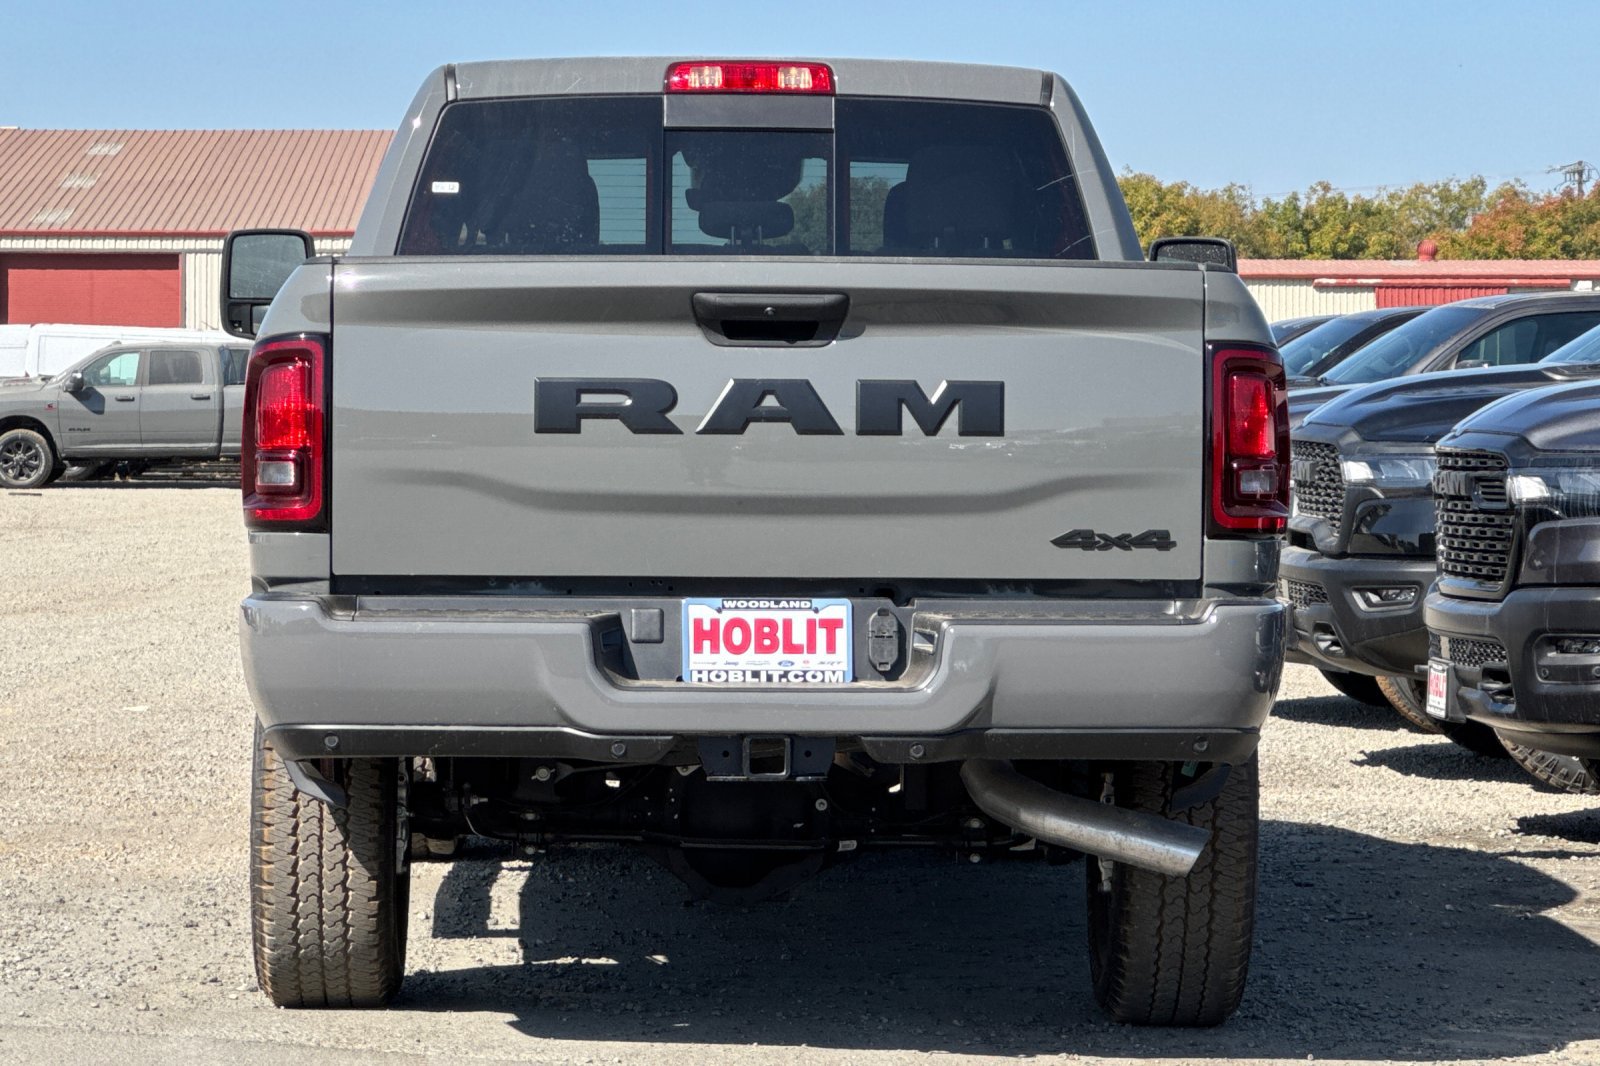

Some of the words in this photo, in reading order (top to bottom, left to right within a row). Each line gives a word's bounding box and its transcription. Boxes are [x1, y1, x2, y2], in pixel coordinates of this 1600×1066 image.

[534, 377, 1005, 436] RAM
[723, 600, 812, 609] WOODLAND
[693, 617, 844, 655] HOBLIT
[691, 670, 844, 683] HOBLIT.COM
